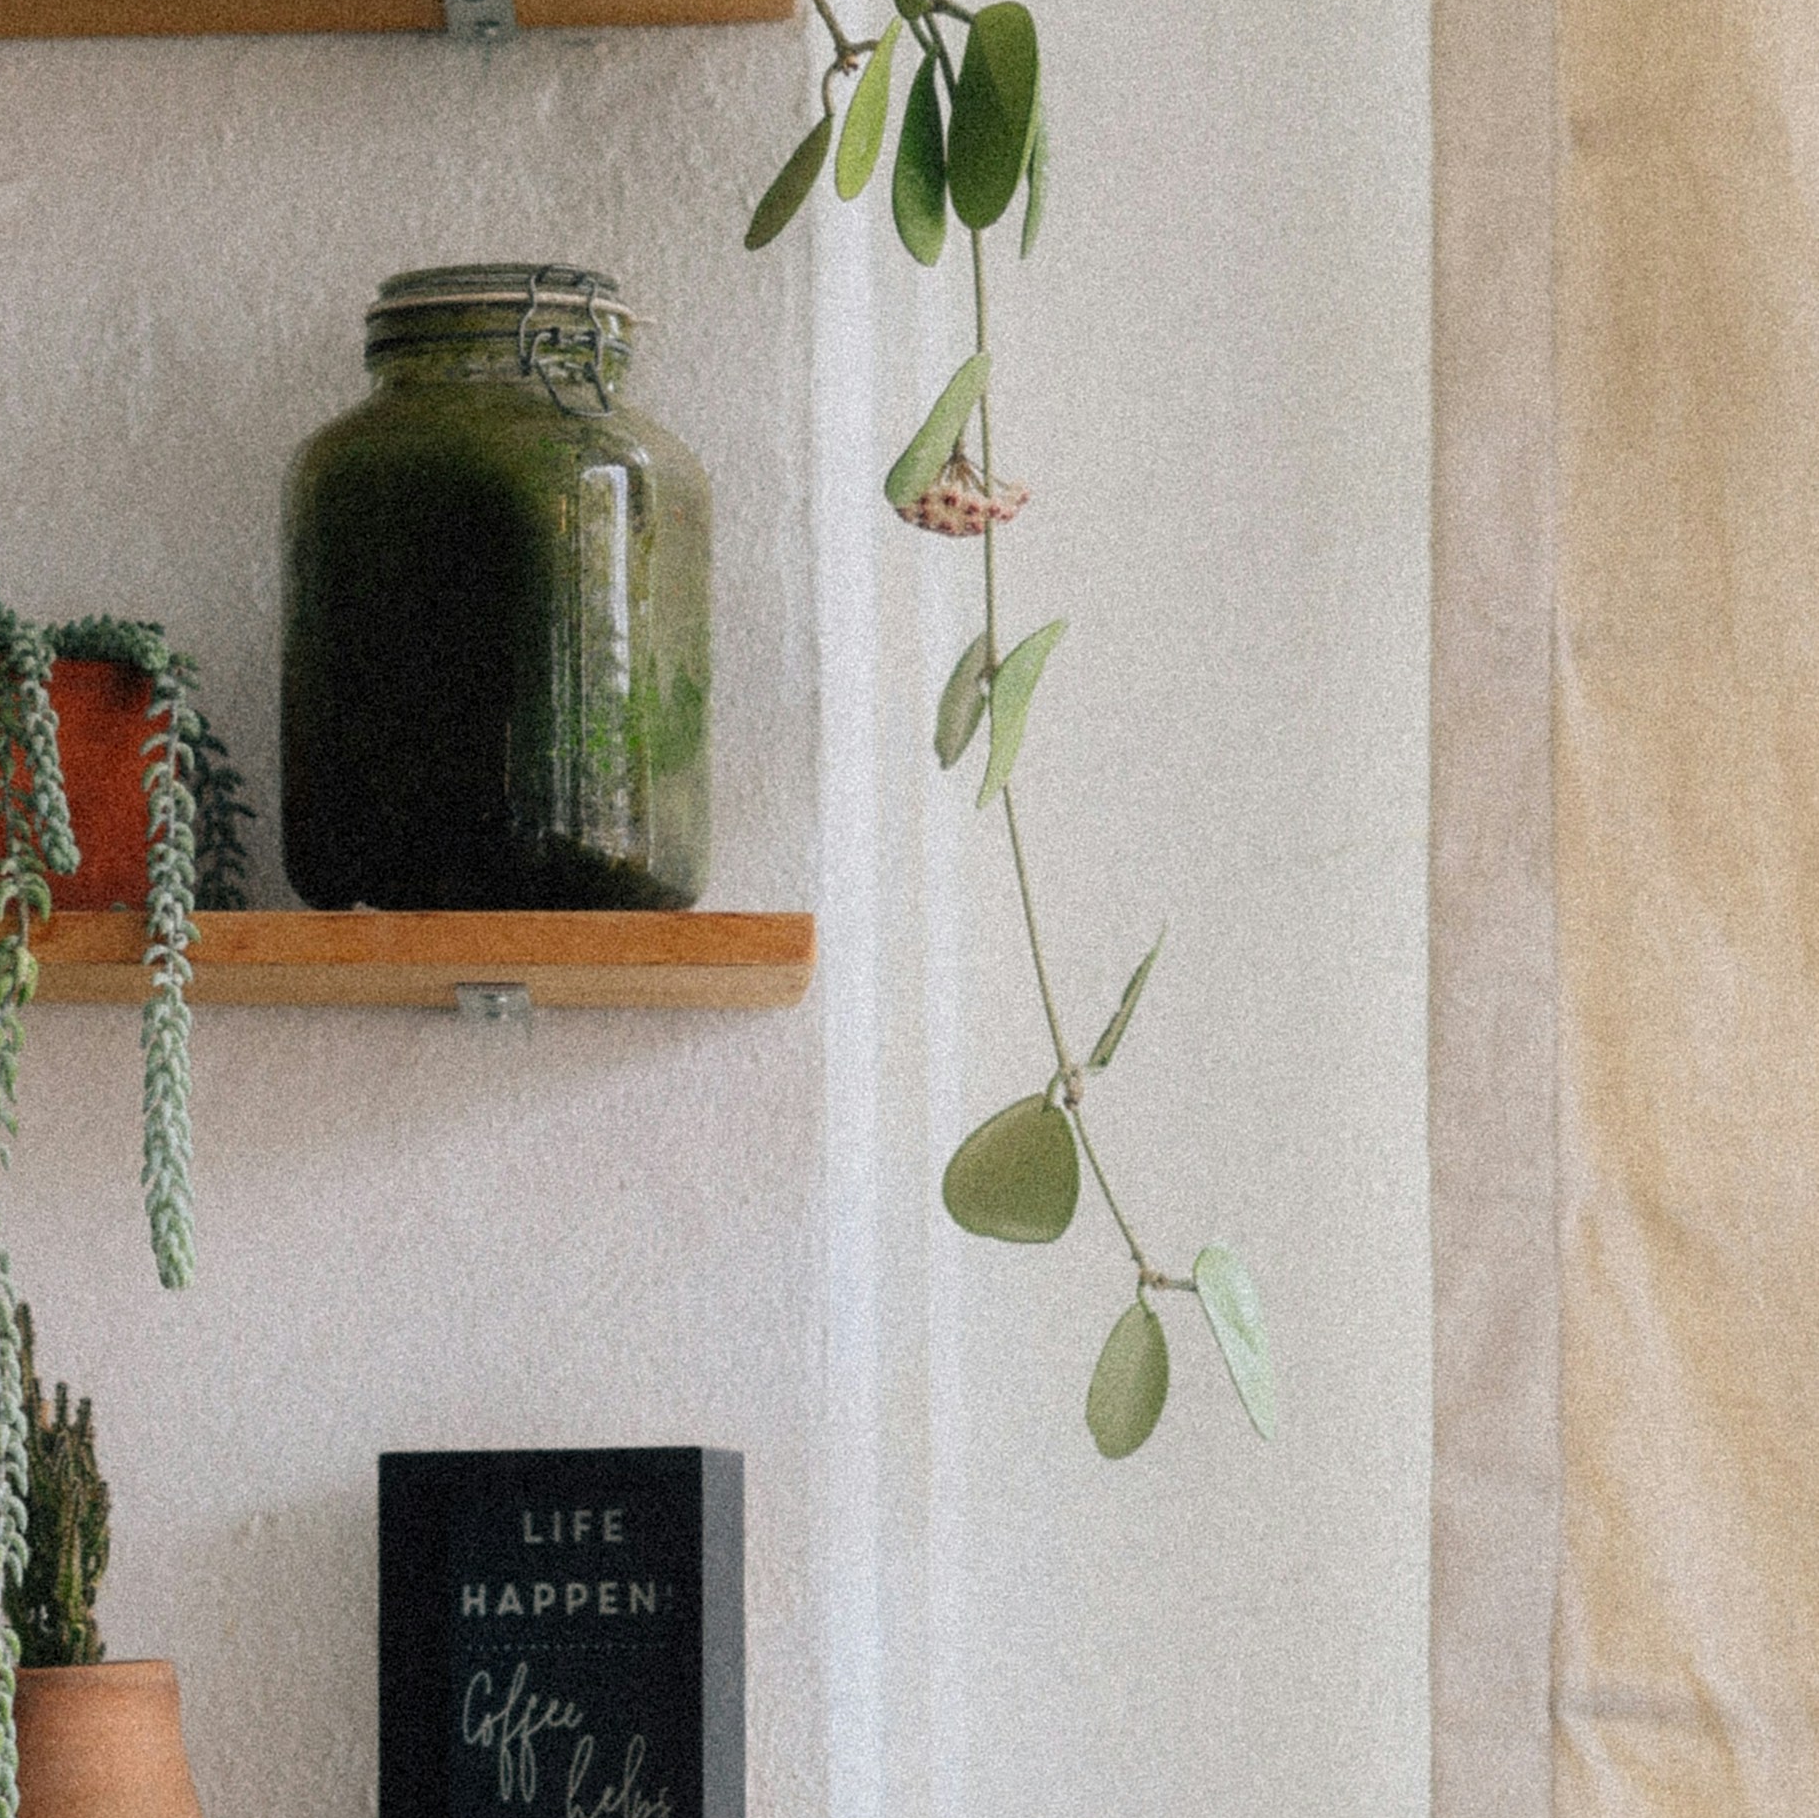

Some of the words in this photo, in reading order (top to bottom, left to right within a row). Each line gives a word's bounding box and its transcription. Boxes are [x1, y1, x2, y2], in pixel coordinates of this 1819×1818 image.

[522, 1509, 625, 1545] LIFE
[461, 1580, 673, 1617] HAPPEN
[462, 1660, 584, 1804] Coffee
